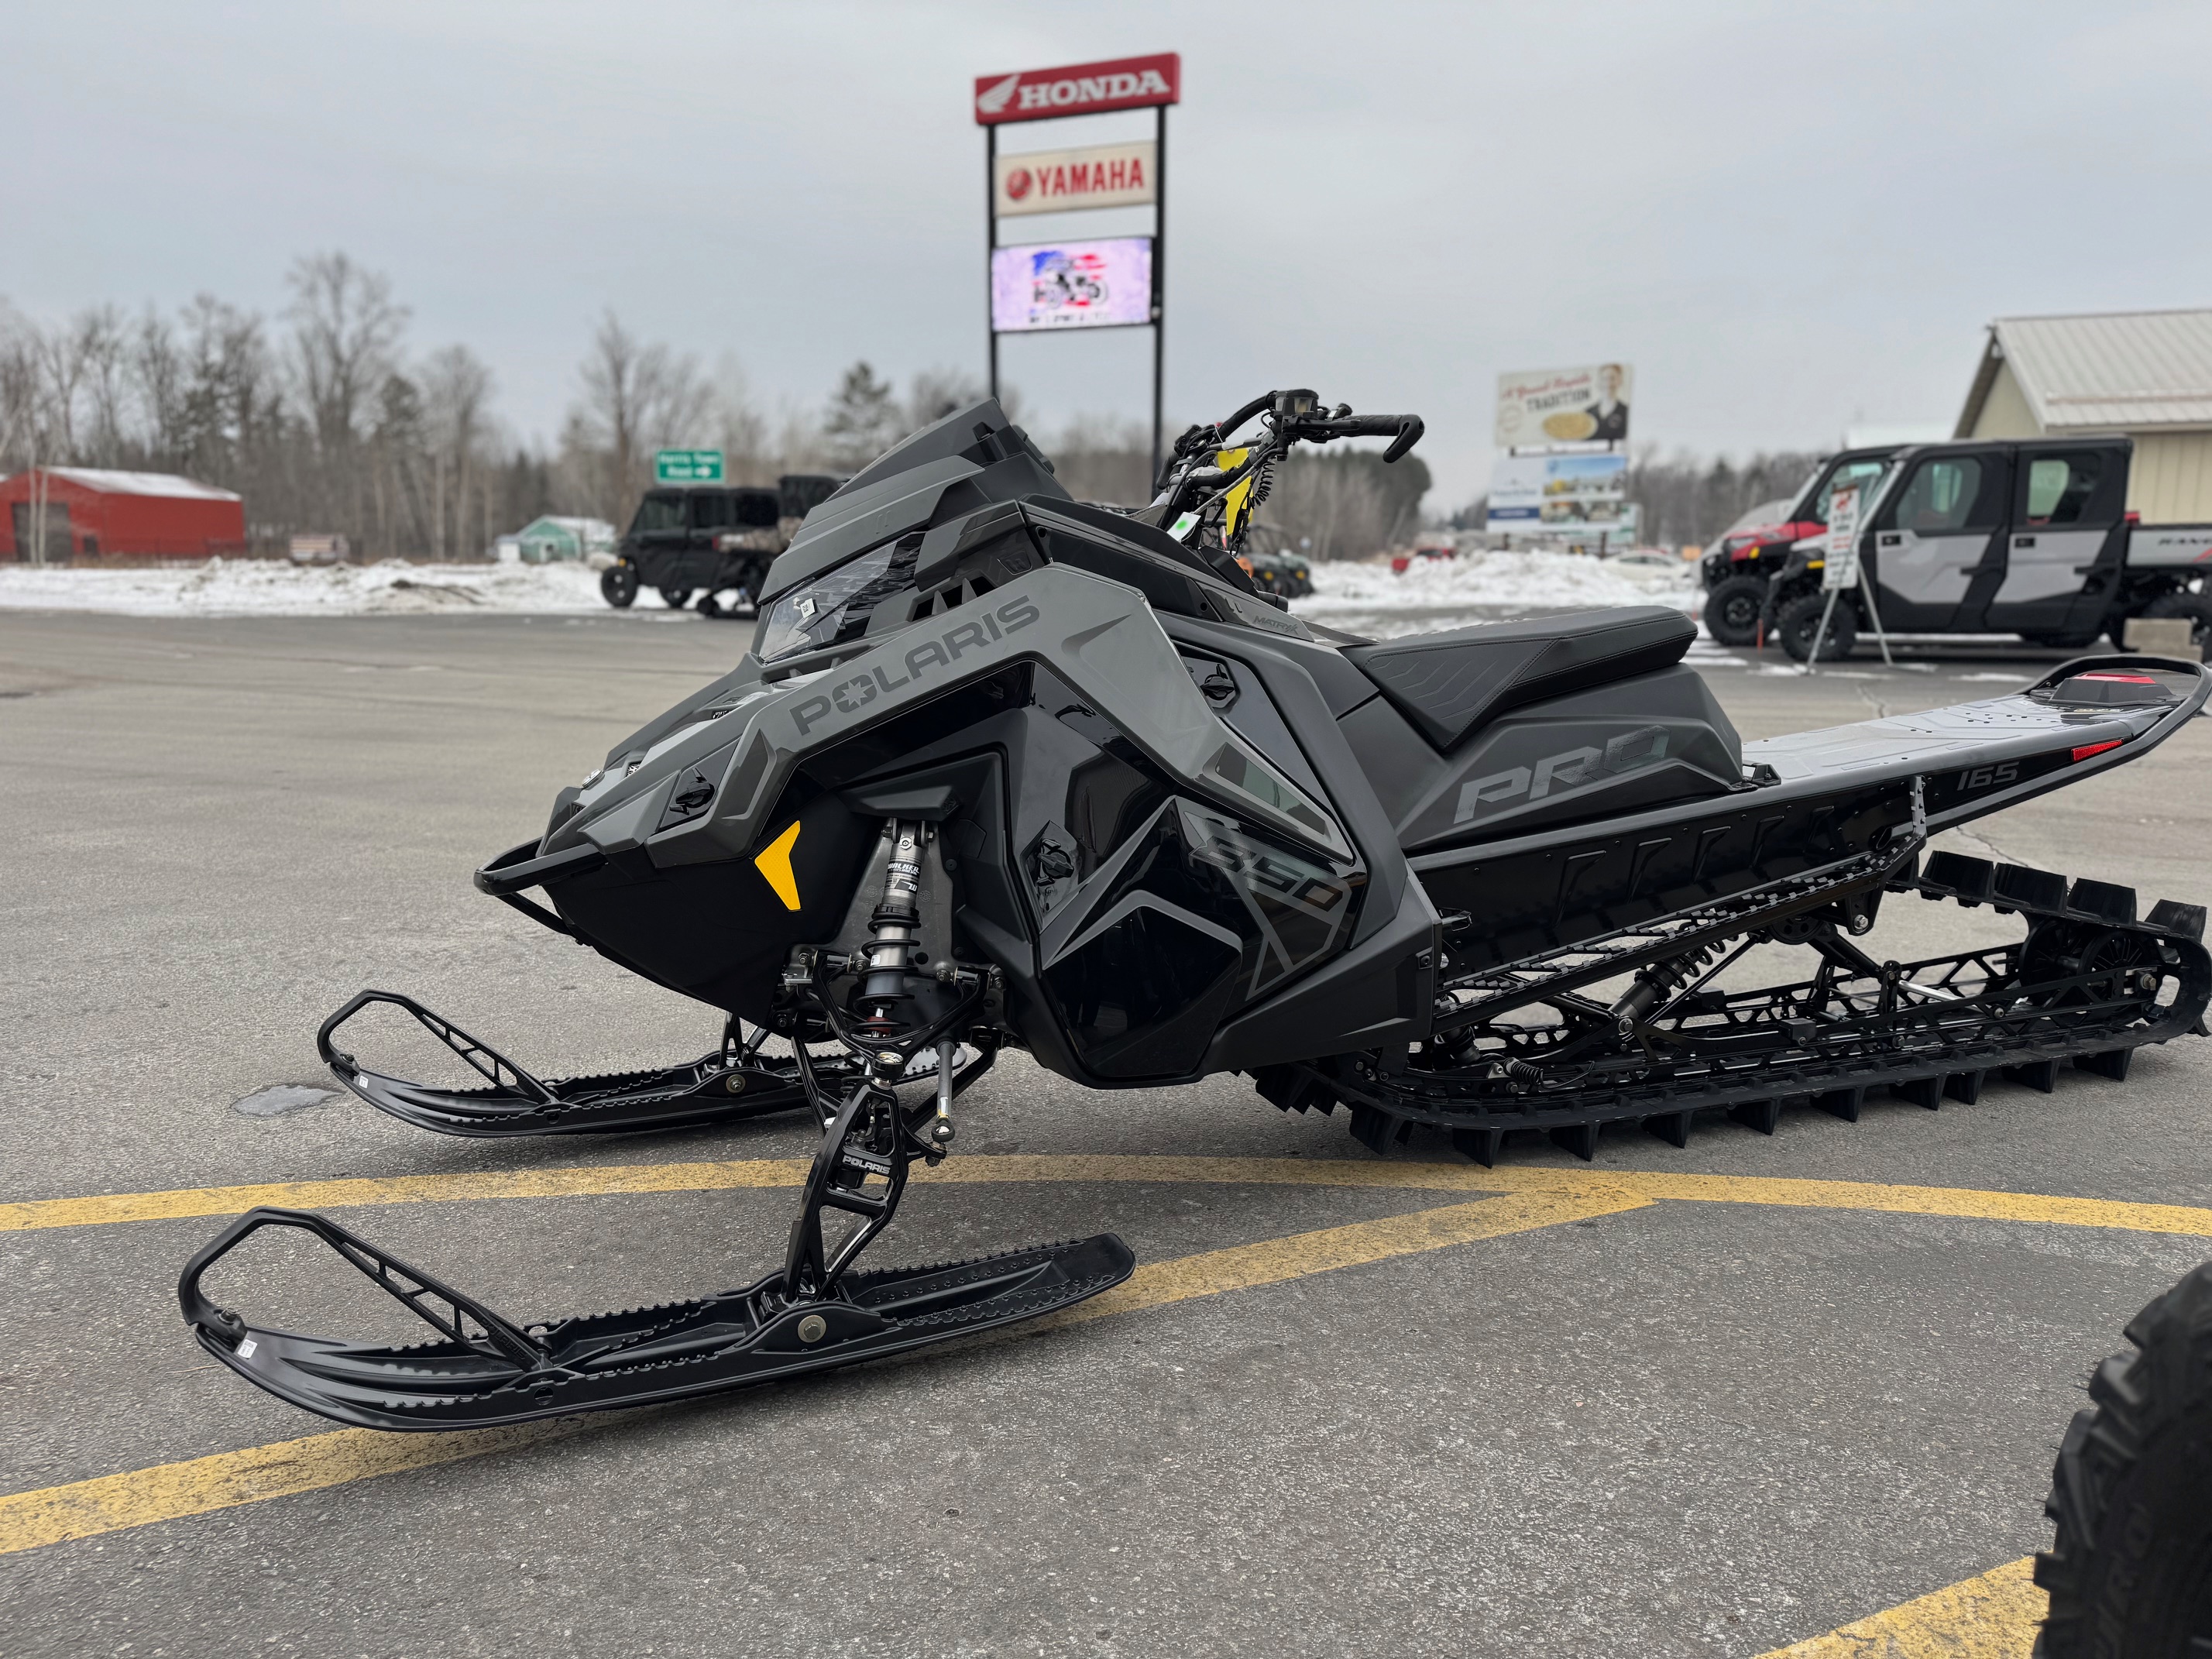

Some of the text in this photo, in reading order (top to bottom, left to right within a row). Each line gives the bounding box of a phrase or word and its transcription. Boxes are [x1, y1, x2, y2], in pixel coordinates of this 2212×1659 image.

[1018, 70, 1171, 109] HONDA
[1036, 158, 1144, 197] YAMAHA
[788, 595, 1040, 736] POLARIS
[1454, 725, 1671, 824] PRO
[1957, 761, 2020, 791] 165
[888, 862, 919, 874] WALKER
[1189, 835, 1344, 912] 850
[843, 1155, 891, 1174] POLARIS
